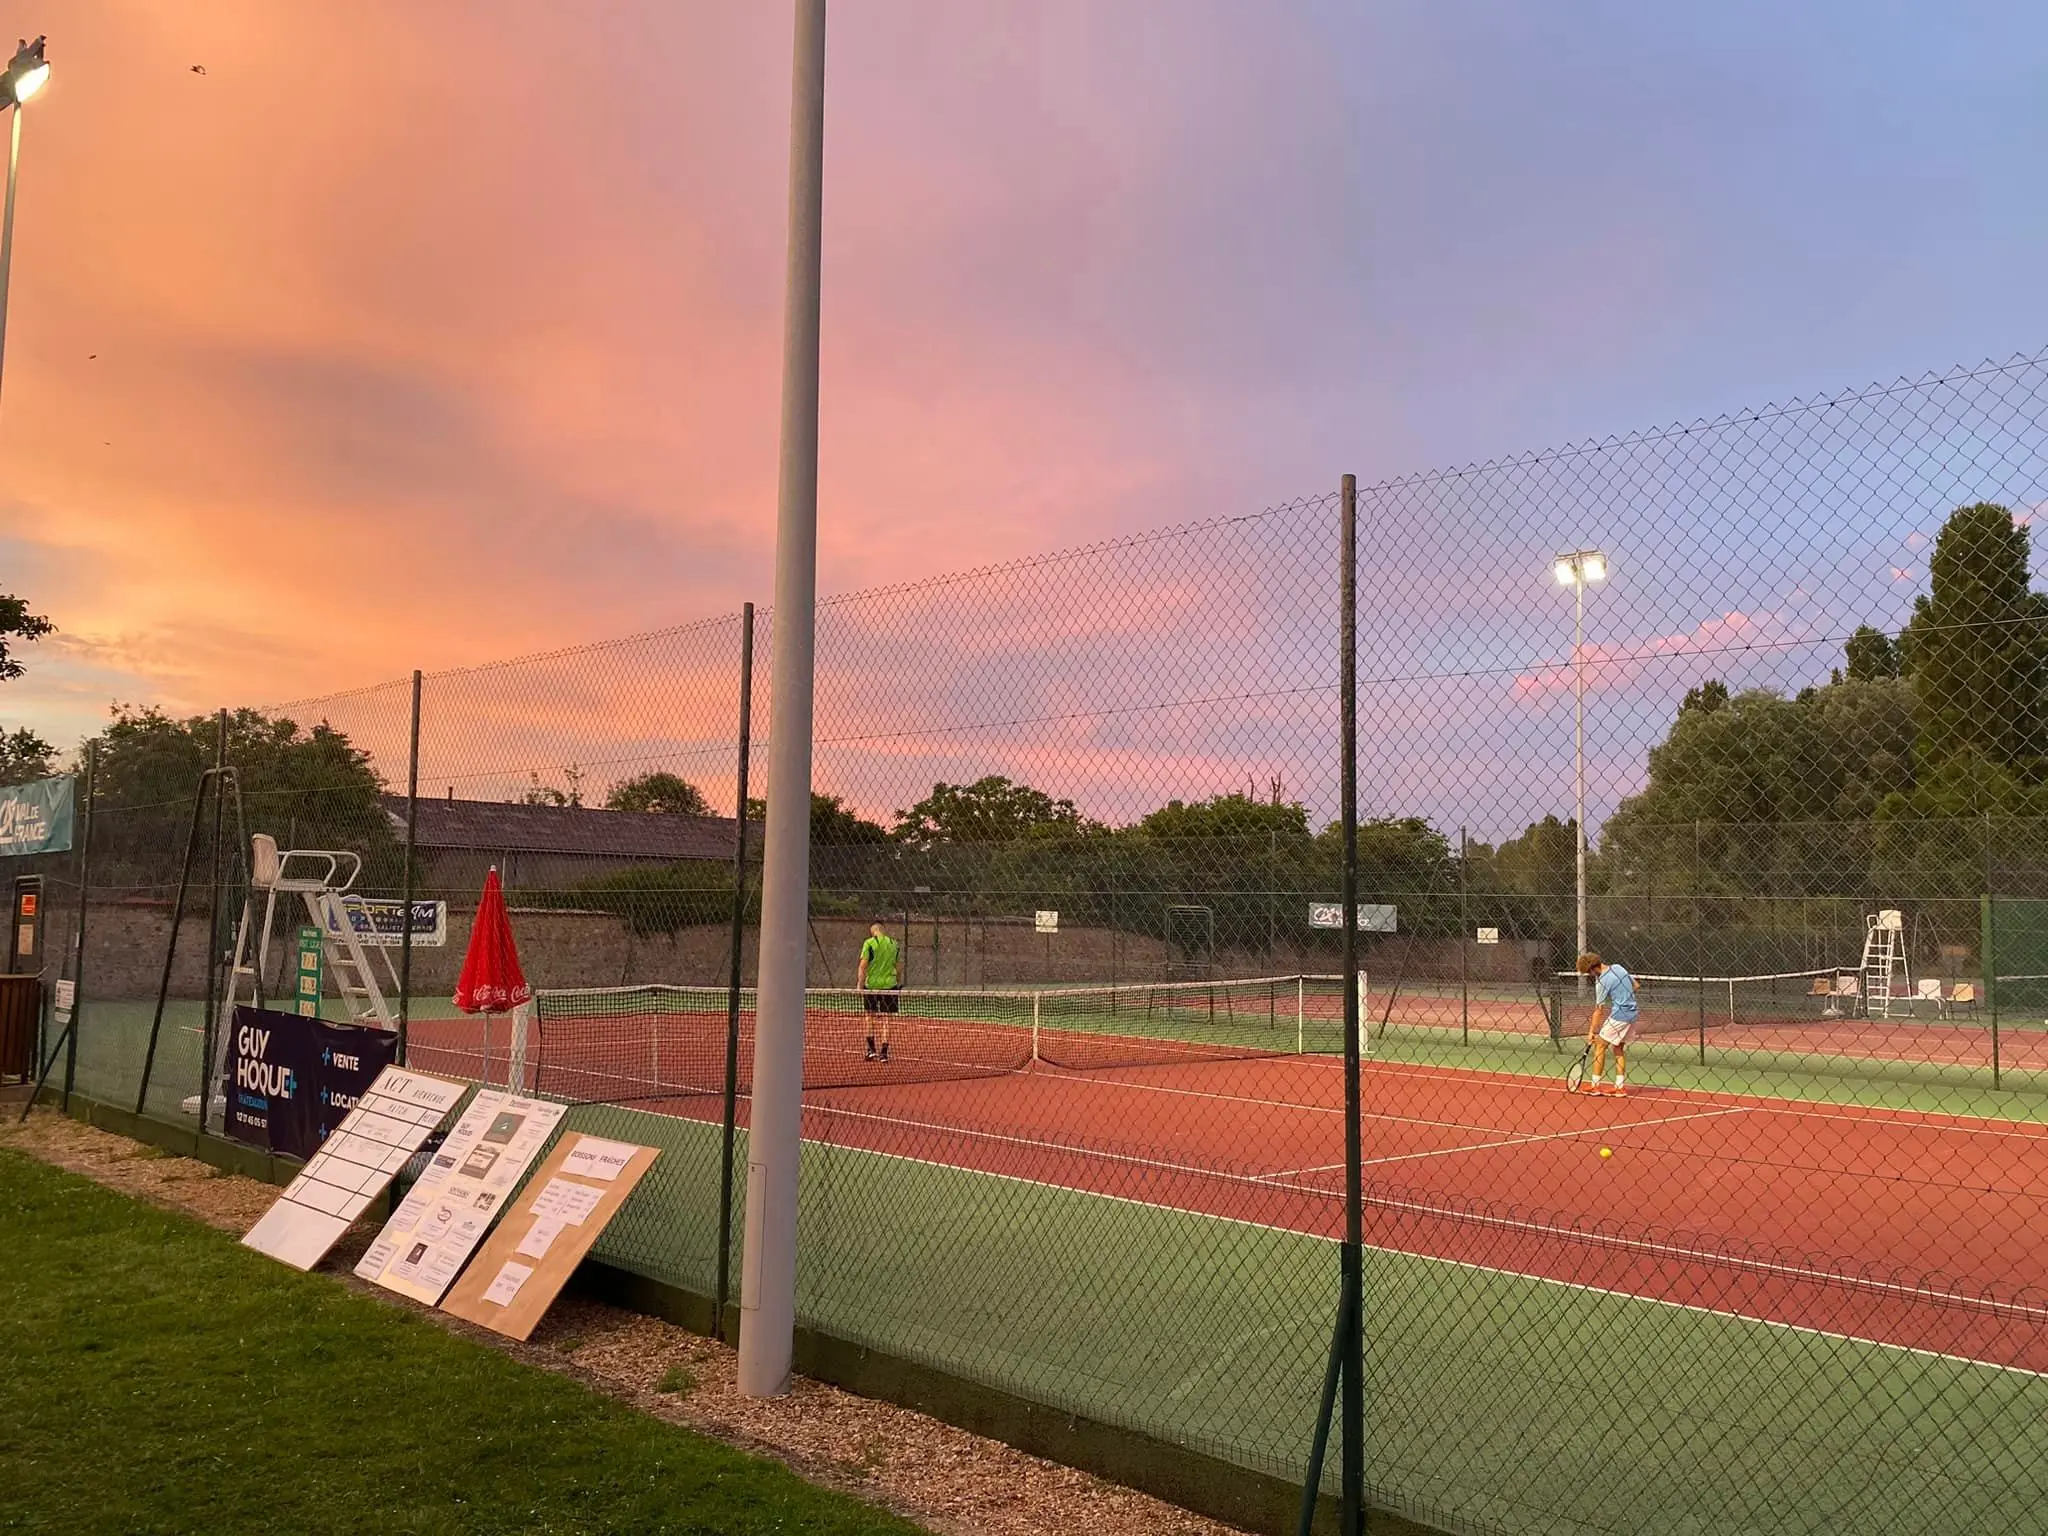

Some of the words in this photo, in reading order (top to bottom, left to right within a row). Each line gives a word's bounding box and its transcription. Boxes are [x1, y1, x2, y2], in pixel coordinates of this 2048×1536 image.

[238, 1025, 270, 1059] GUY
[333, 1052, 360, 1071] VENTE
[383, 1075, 412, 1094] ACT
